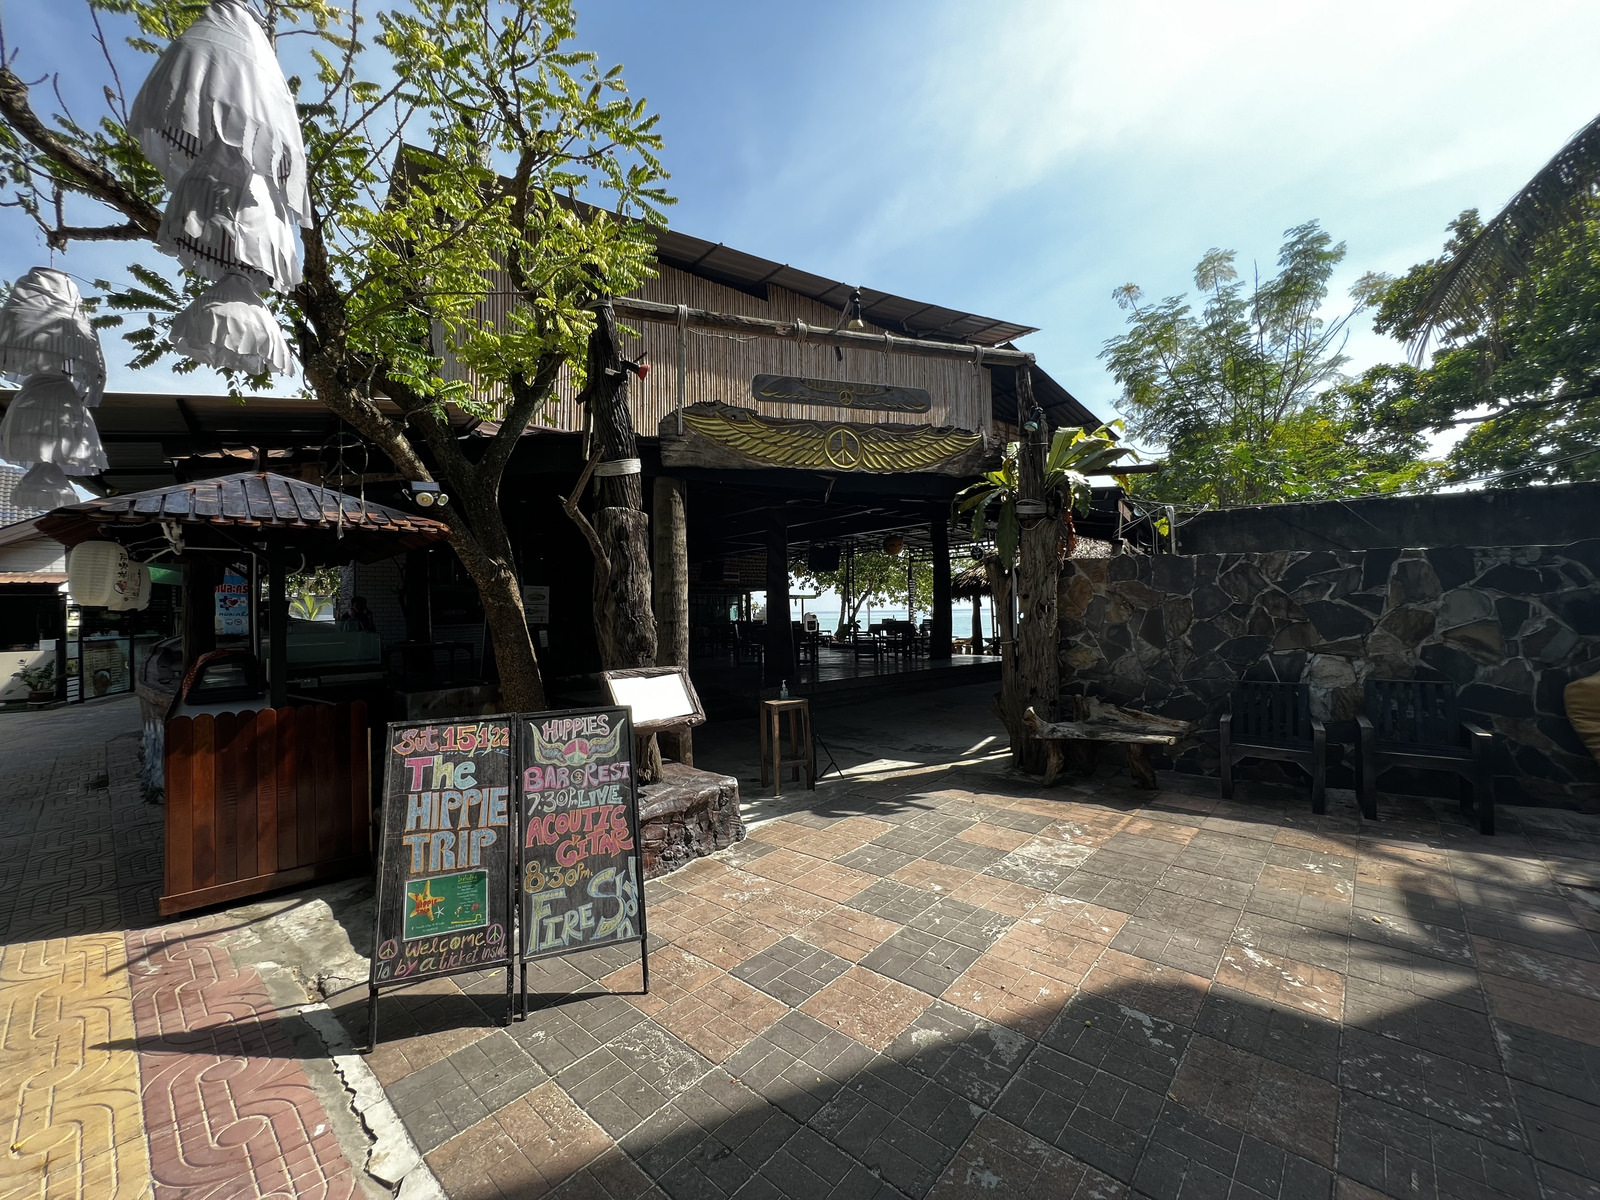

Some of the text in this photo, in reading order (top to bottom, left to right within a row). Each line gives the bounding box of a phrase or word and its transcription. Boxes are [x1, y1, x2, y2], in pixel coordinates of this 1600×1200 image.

[541, 714, 610, 743] HIPPIES
[405, 755, 478, 791] The
[523, 766, 570, 792] BAR
[581, 762, 631, 788] REST
[404, 786, 508, 833] HIPPIE
[577, 785, 623, 808] LIVE
[525, 805, 628, 848] ACOUTIC
[403, 828, 497, 874] TRIP
[526, 888, 595, 956] FIRE
[394, 959, 418, 977] by
[420, 957, 437, 972] a
[439, 946, 477, 970] ticket
[481, 933, 508, 960] inside
